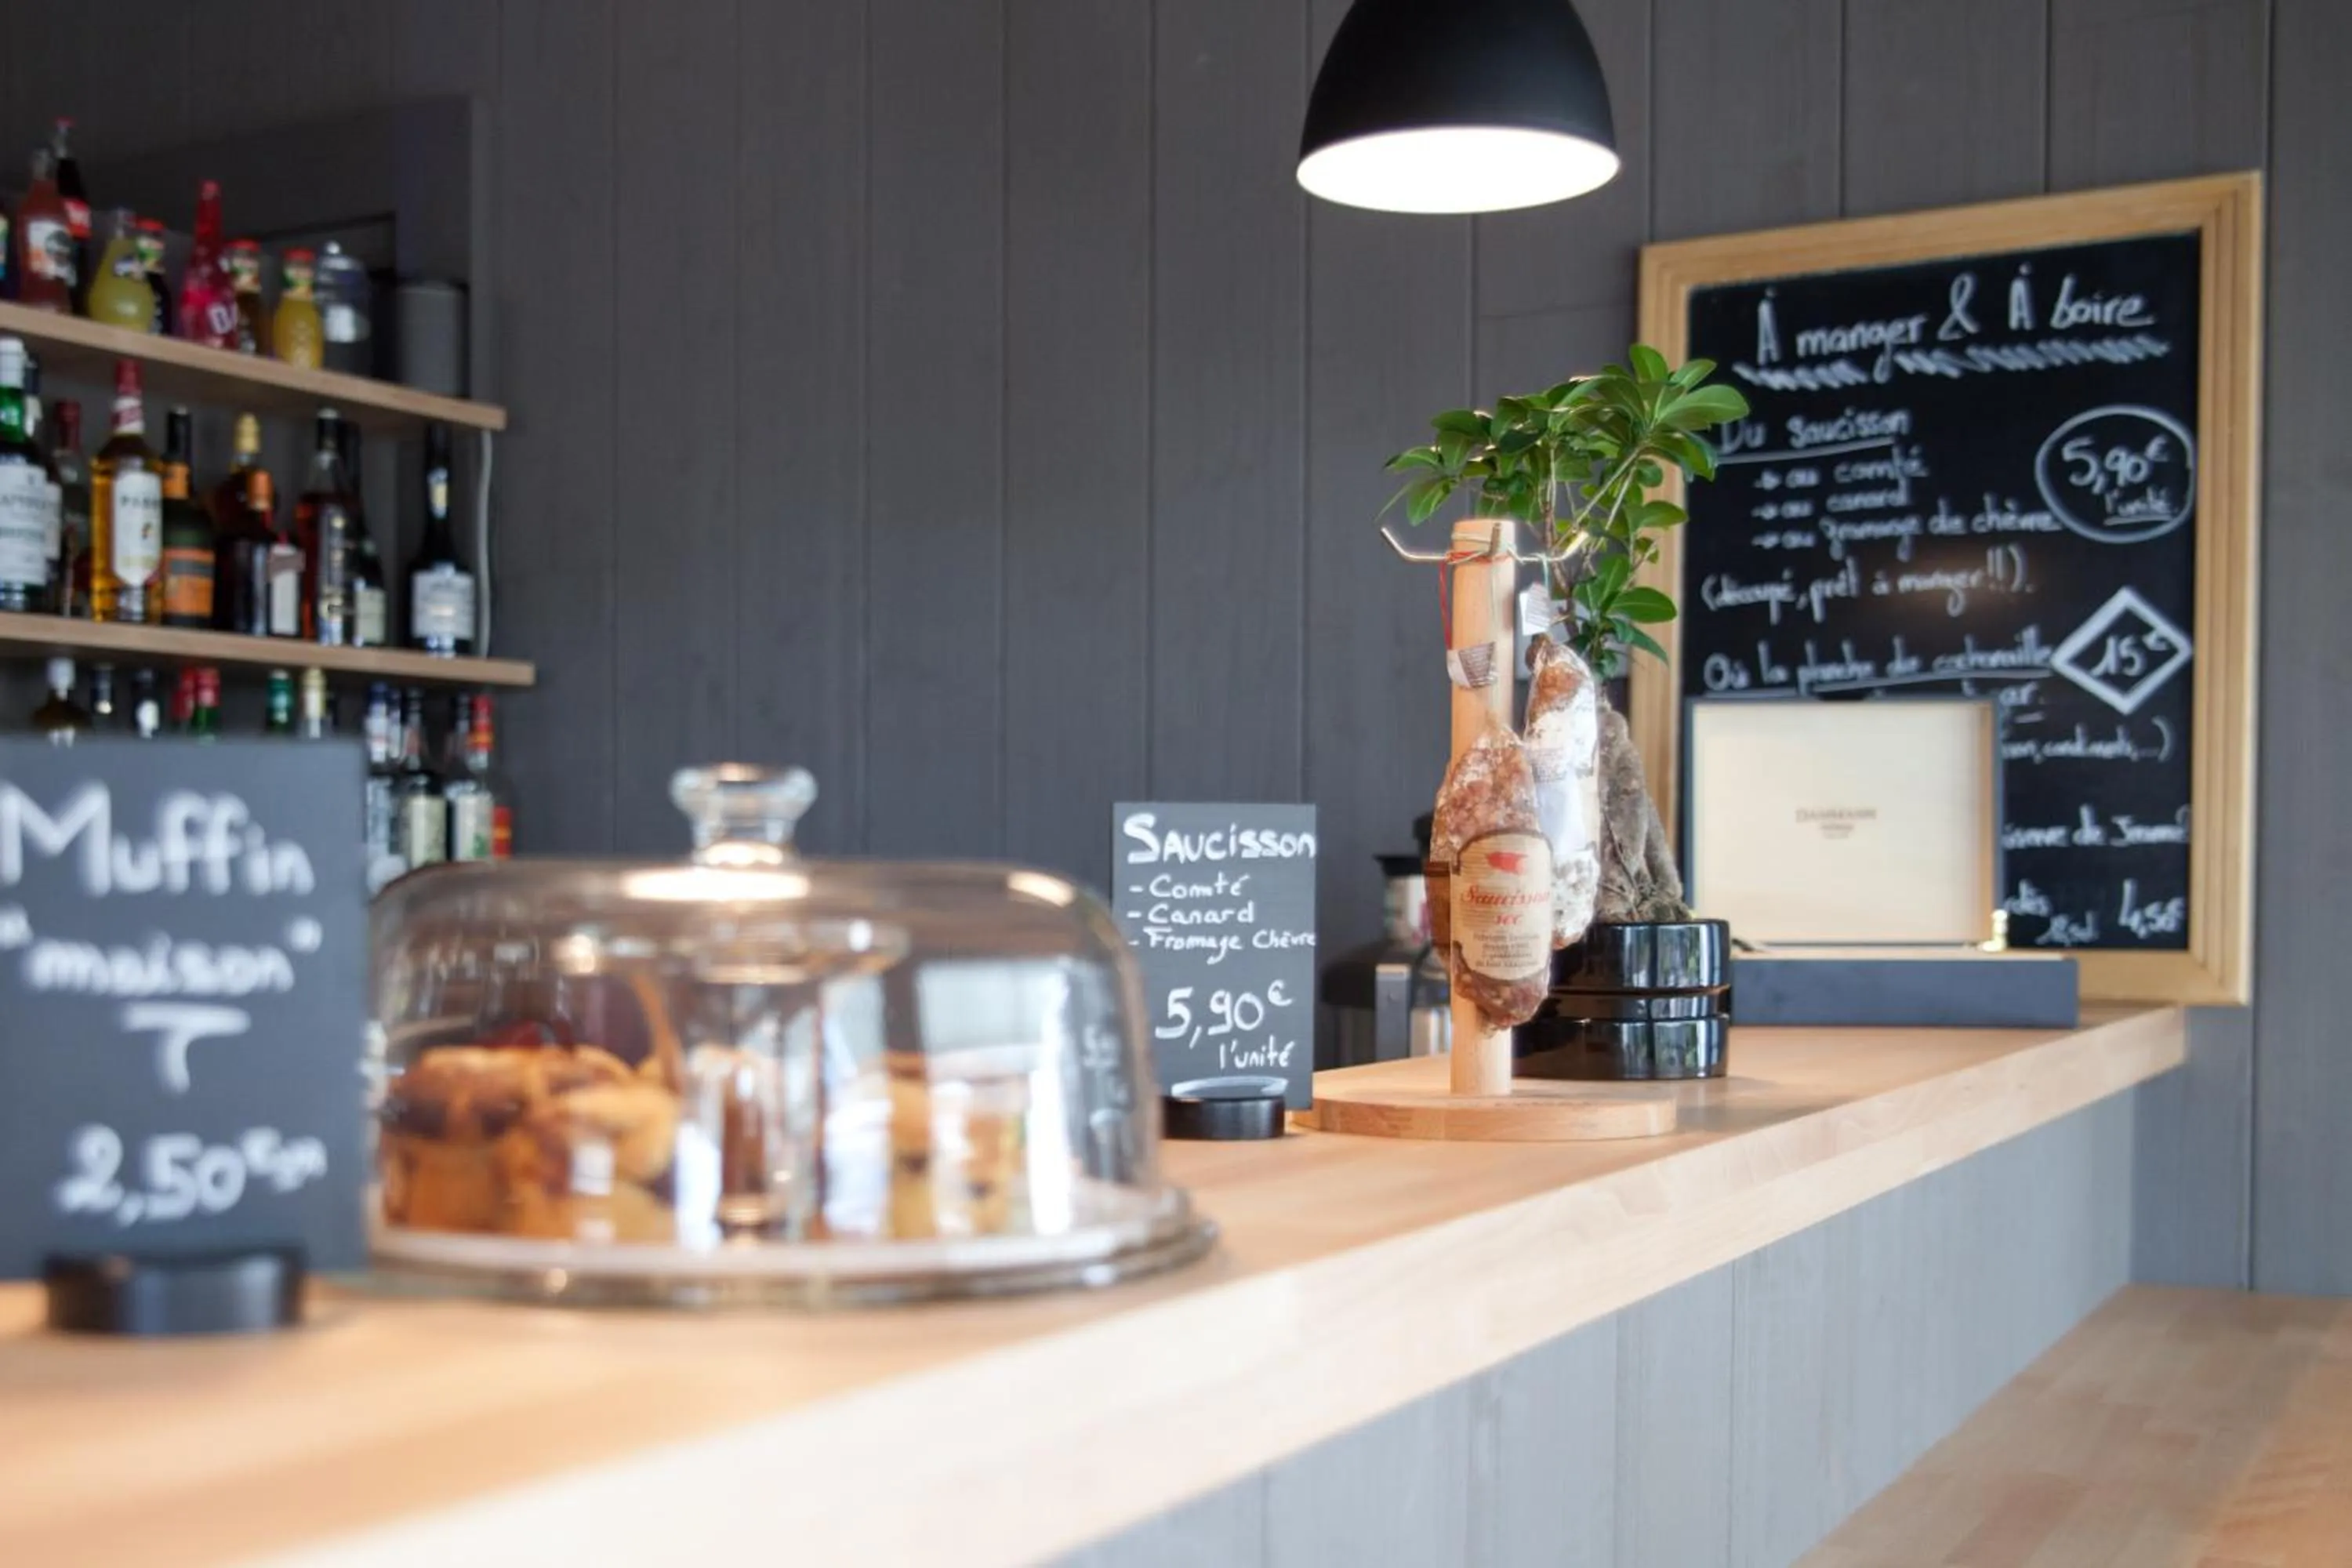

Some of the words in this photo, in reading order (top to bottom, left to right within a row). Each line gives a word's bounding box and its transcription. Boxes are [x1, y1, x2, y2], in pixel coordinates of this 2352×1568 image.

[1795, 313, 1929, 384] manger
[1937, 271, 1979, 342] &
[2049, 271, 2159, 329] boire
[1720, 420, 1766, 455] Du
[1784, 406, 1911, 449] Saucisson
[2061, 434, 2170, 495] 5,90€
[1928, 495, 1968, 535] de
[1756, 638, 1791, 686] la
[1886, 634, 1923, 679] de
[0, 780, 315, 896] Muffin
[1155, 978, 1294, 1049] 5,90€
[1218, 1033, 1296, 1070] l'unité
